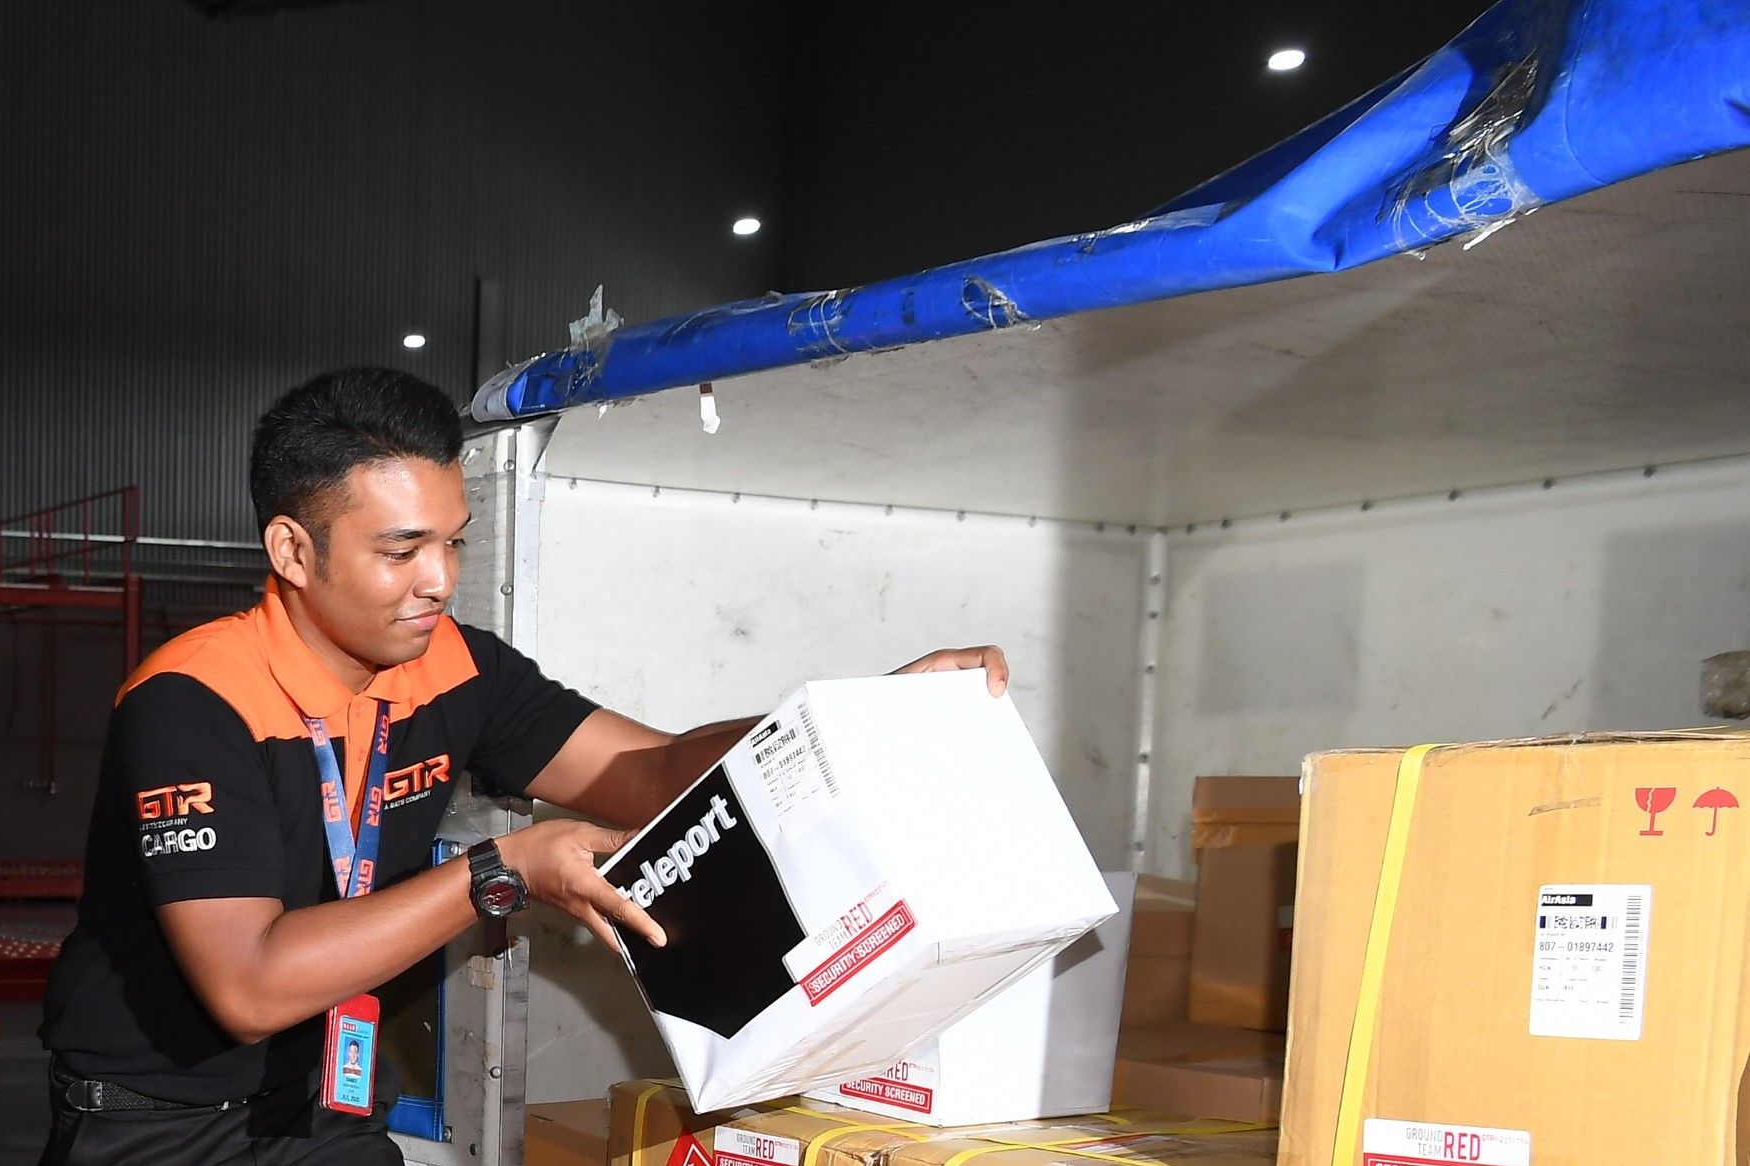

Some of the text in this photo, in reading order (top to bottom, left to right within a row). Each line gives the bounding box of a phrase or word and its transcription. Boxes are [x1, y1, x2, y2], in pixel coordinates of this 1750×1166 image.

[383, 754, 450, 801] GTR
[137, 782, 214, 819] GTR
[320, 780, 342, 823] GTR
[366, 786, 382, 827] GTR
[142, 827, 217, 857] CARGO
[1541, 895, 1577, 905] AirAsia
[840, 901, 873, 937] RED
[808, 914, 907, 993] SECURITY SCREENED
[1539, 941, 1614, 953] 807 01897442
[846, 1079, 926, 1106] SECURITY SCREENED
[755, 1138, 775, 1160] RED
[1406, 1127, 1443, 1142] GROUND
[1444, 1132, 1481, 1161] RED
[1418, 1143, 1442, 1157] TEAM
